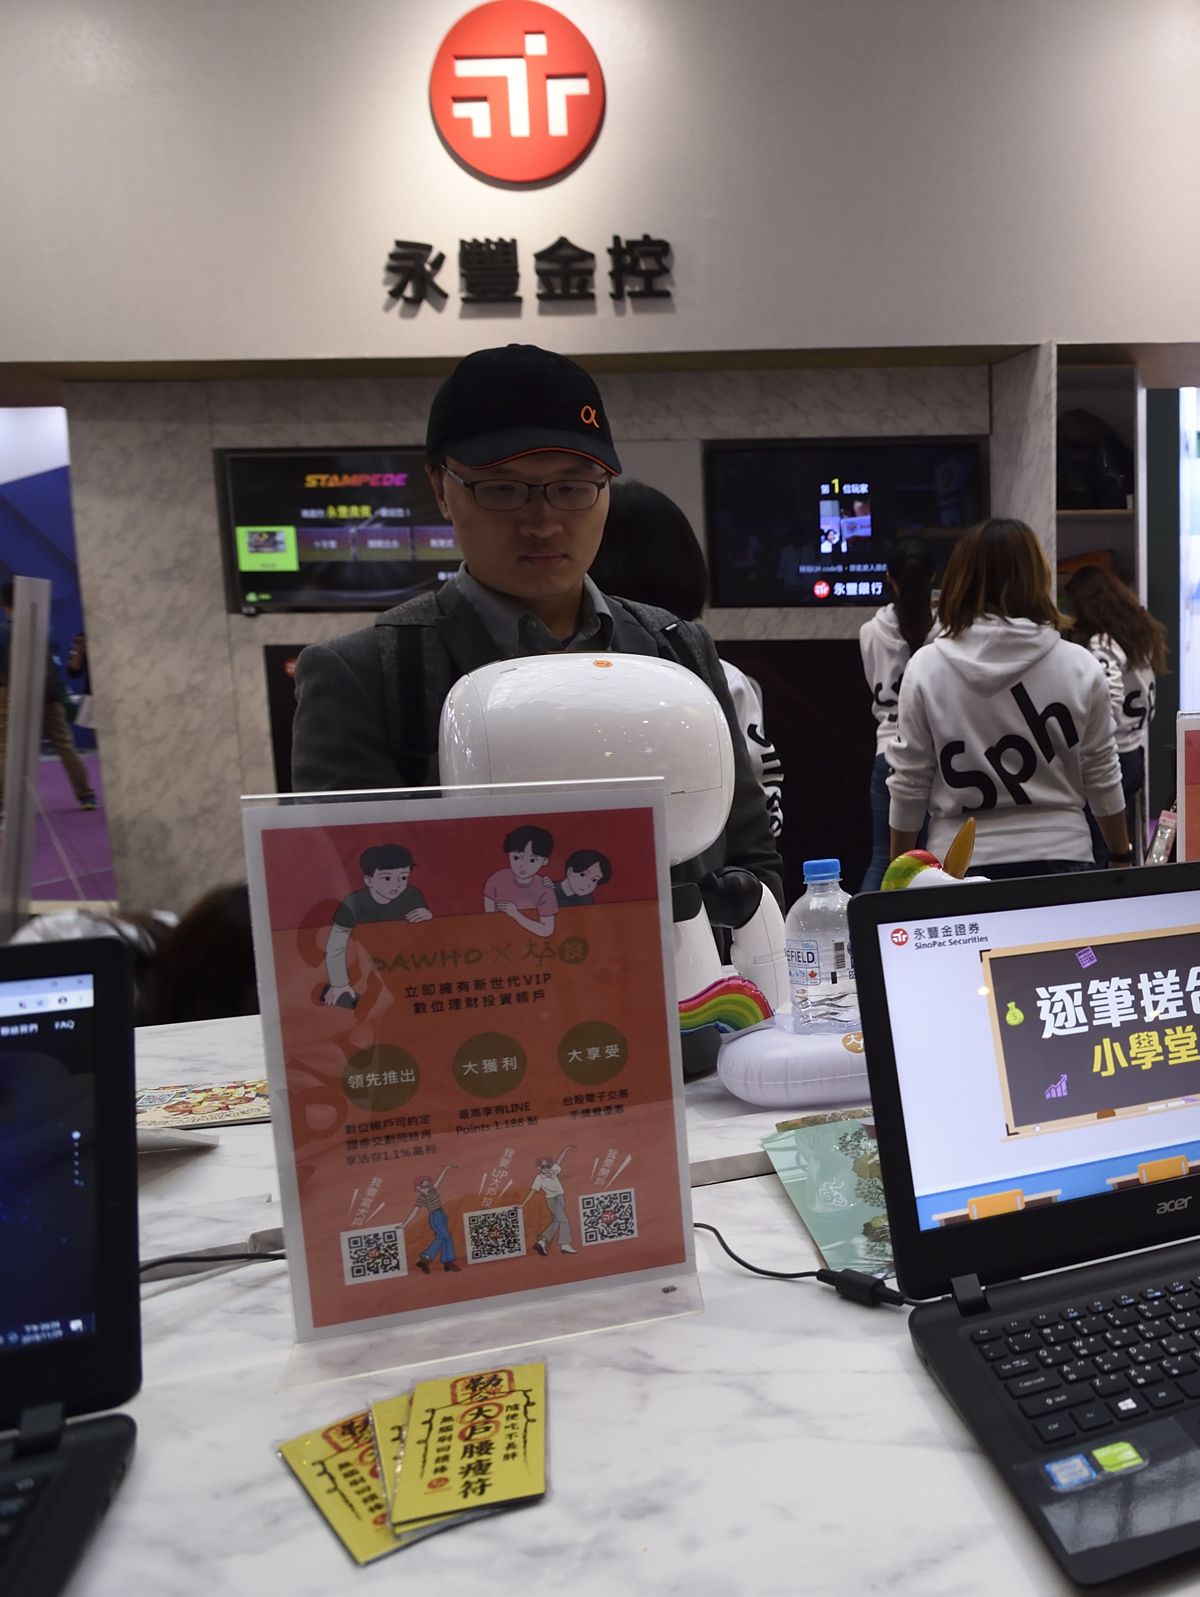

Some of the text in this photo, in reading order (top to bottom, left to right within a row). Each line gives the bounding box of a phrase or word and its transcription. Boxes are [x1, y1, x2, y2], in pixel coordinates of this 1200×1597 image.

[387, 234, 674, 305] 永豐金控
[304, 473, 409, 488] STAMPEDE
[940, 681, 1079, 813] Sph
[913, 922, 980, 941] 永豐金證券
[914, 935, 989, 950] SinoPac Securities
[404, 973, 552, 999] 立即擁有新世代VIP
[413, 989, 546, 1015] 數位理財投資帳戶
[54, 1019, 76, 1031] FAQ
[567, 1043, 621, 1064] 大享受
[462, 1055, 518, 1076] 大獲利
[347, 1068, 416, 1090] 領先推出
[562, 1089, 630, 1106] 台股電子交易
[456, 1123, 490, 1135] Points
[1156, 1196, 1193, 1215] acer
